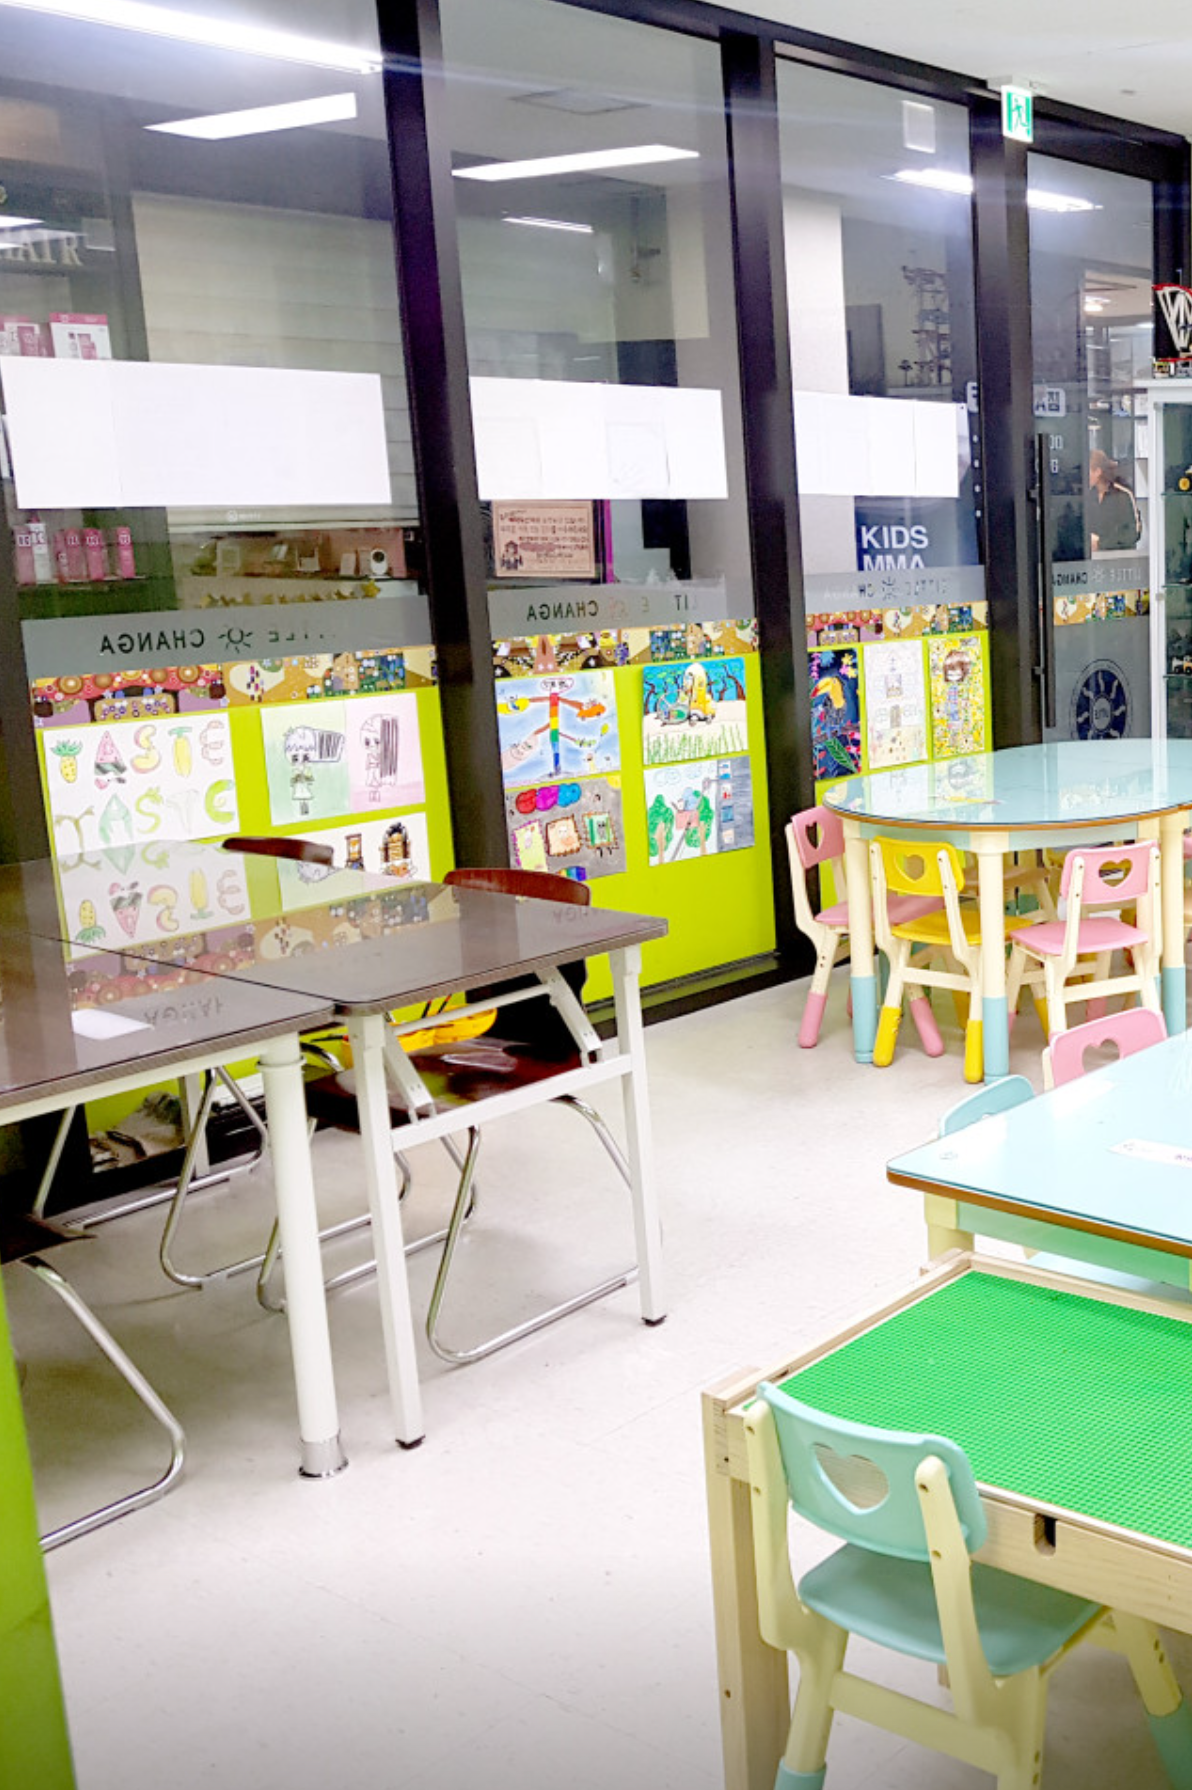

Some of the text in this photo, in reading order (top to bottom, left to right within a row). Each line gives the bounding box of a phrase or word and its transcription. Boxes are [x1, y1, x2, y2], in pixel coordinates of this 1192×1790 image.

[861, 525, 929, 549] KIDS
[863, 554, 925, 571] MMA
[50, 718, 225, 787] TASTE
